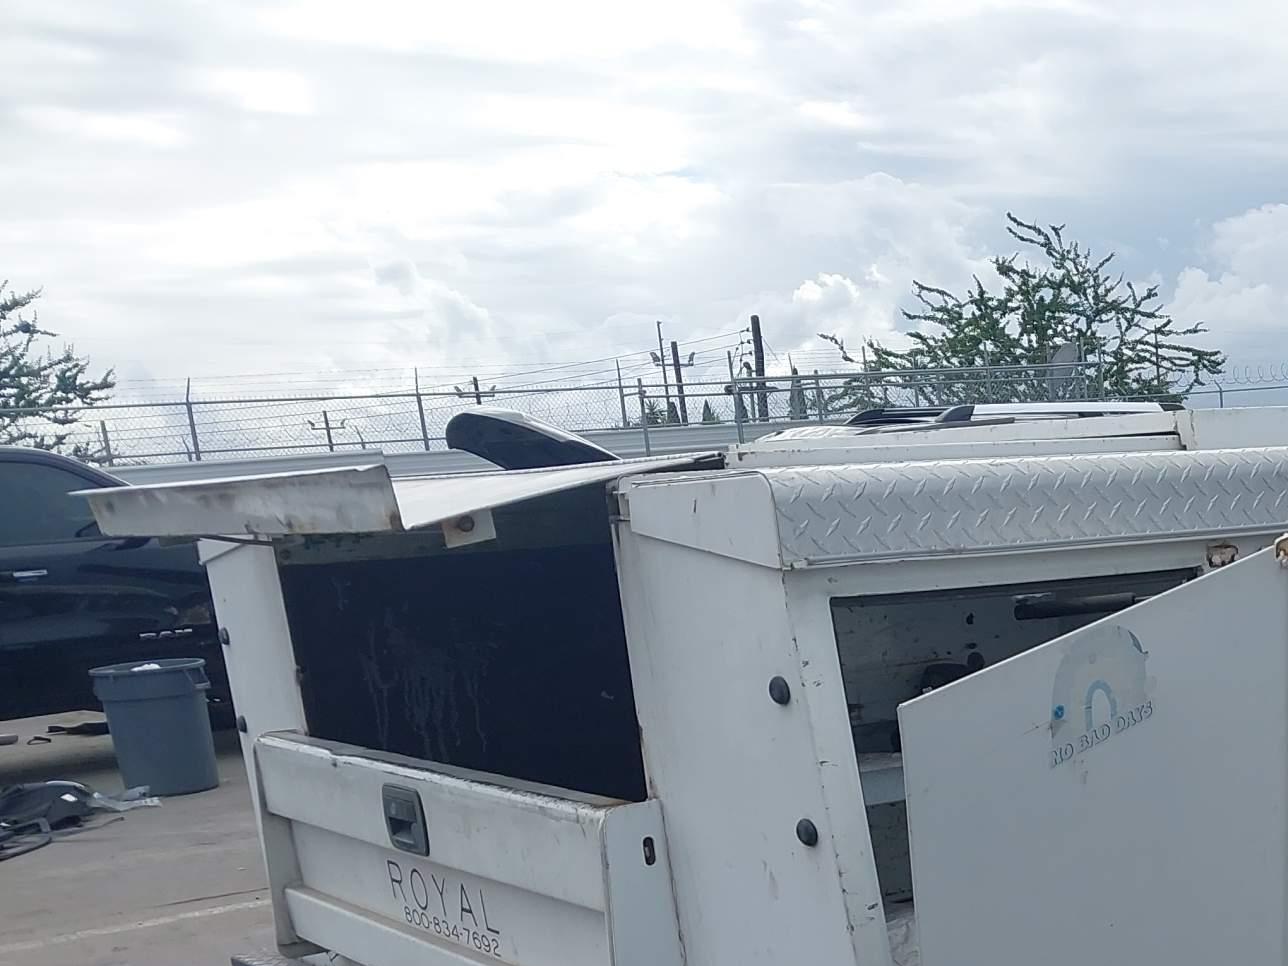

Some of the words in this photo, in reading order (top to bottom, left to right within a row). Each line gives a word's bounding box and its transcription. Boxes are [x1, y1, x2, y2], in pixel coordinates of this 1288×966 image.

[1051, 743, 1074, 769] NO
[1077, 723, 1111, 754] BAD
[1115, 700, 1153, 735] DAYS
[386, 859, 500, 935] ROYAL
[403, 905, 502, 958] 800-834-7692
